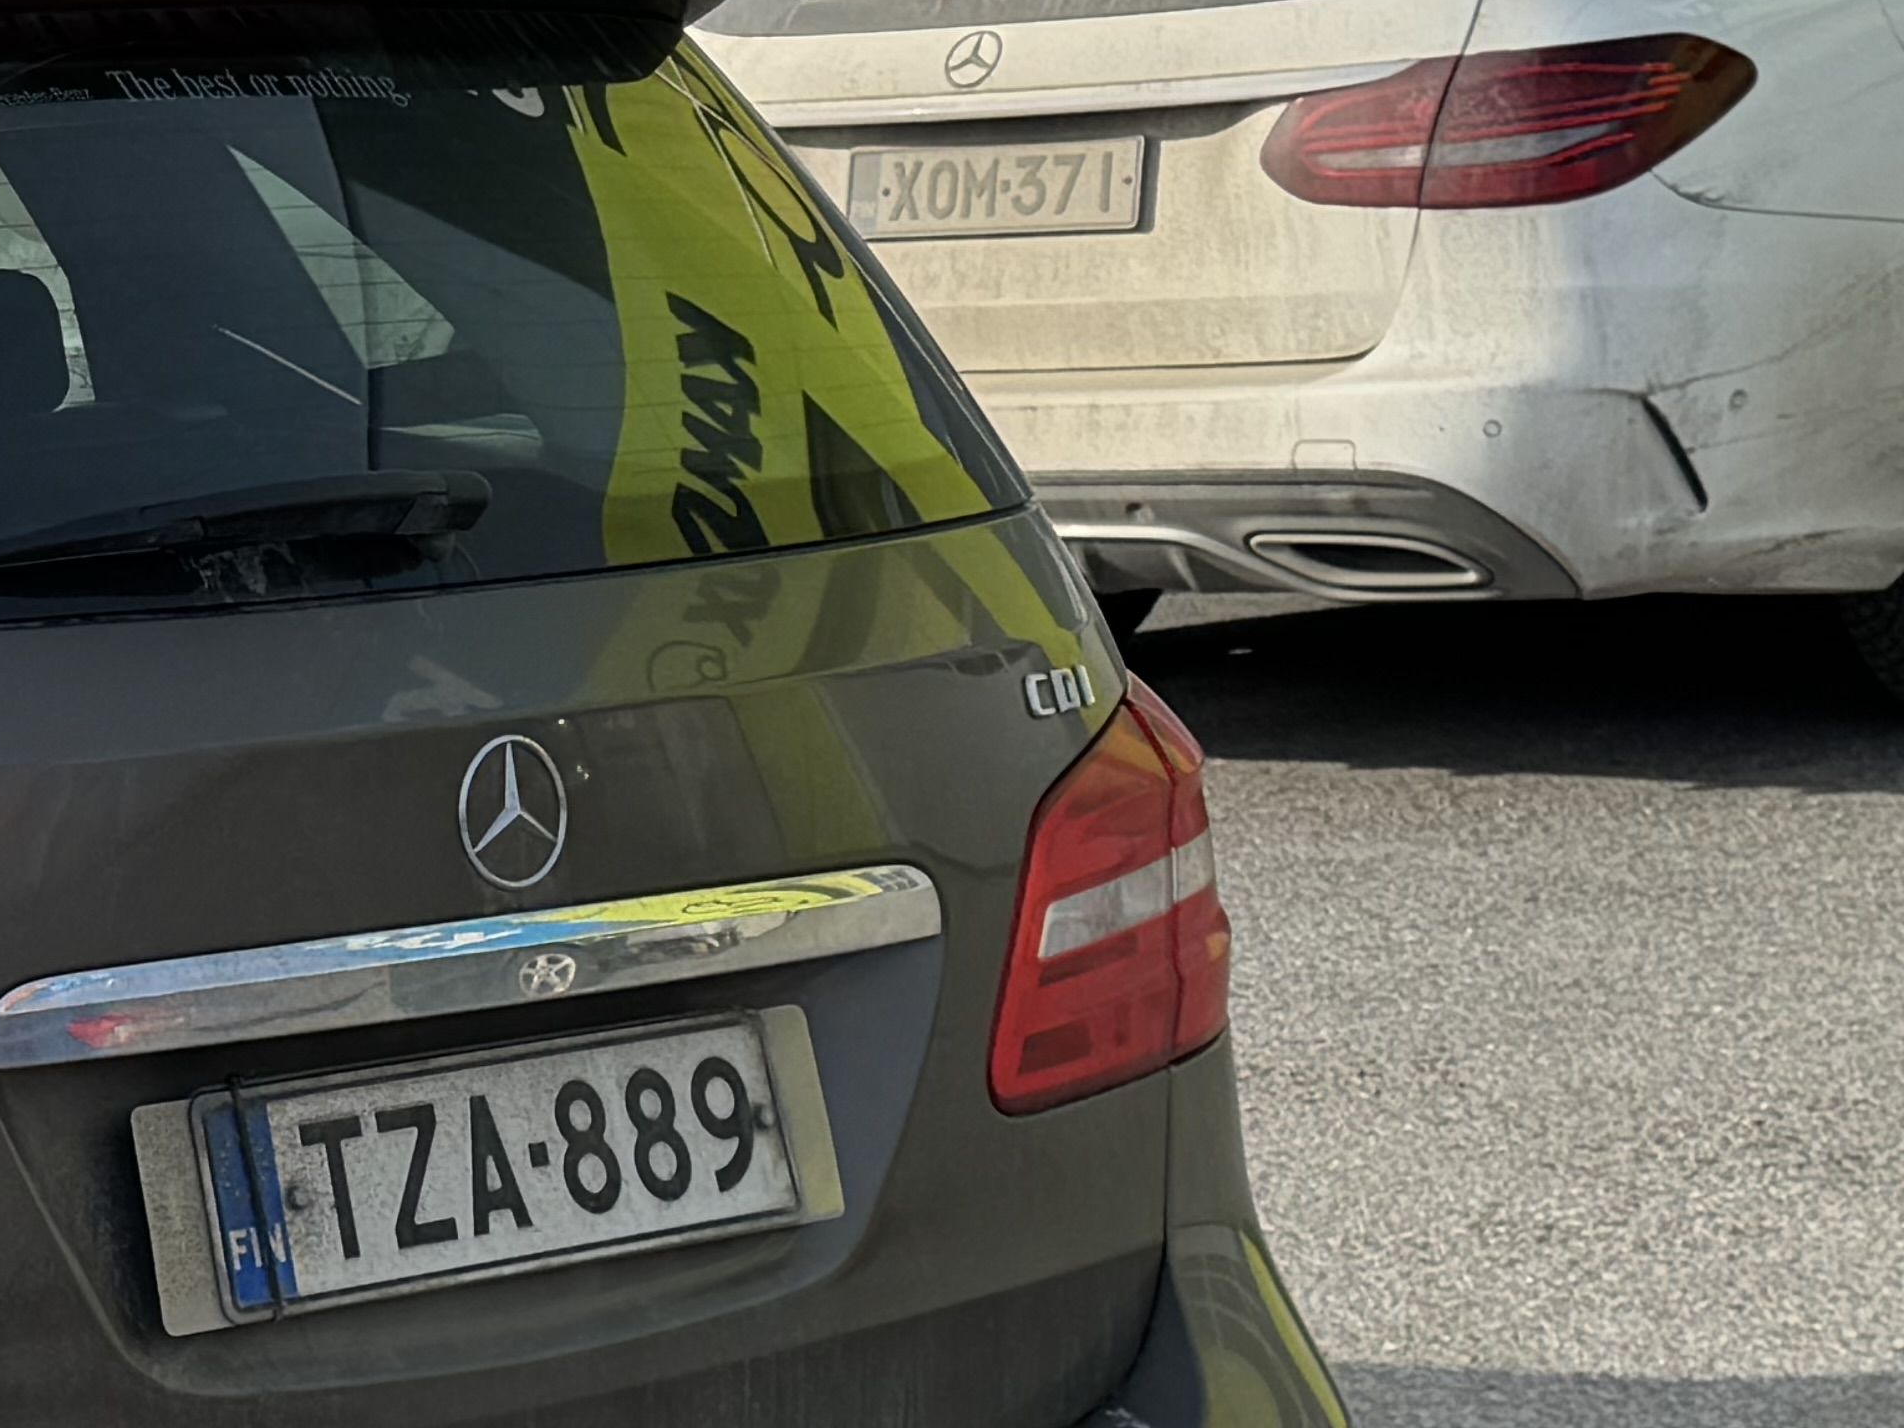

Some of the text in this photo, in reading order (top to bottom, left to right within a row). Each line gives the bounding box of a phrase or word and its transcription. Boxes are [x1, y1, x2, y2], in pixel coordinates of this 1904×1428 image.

[105, 70, 176, 102] The
[171, 68, 249, 99] best
[249, 74, 283, 98] or
[889, 151, 1114, 221] XOM-371
[1025, 664, 1096, 716] CDI
[298, 1056, 754, 1260] TZA-889
[228, 1223, 288, 1271] FIN
